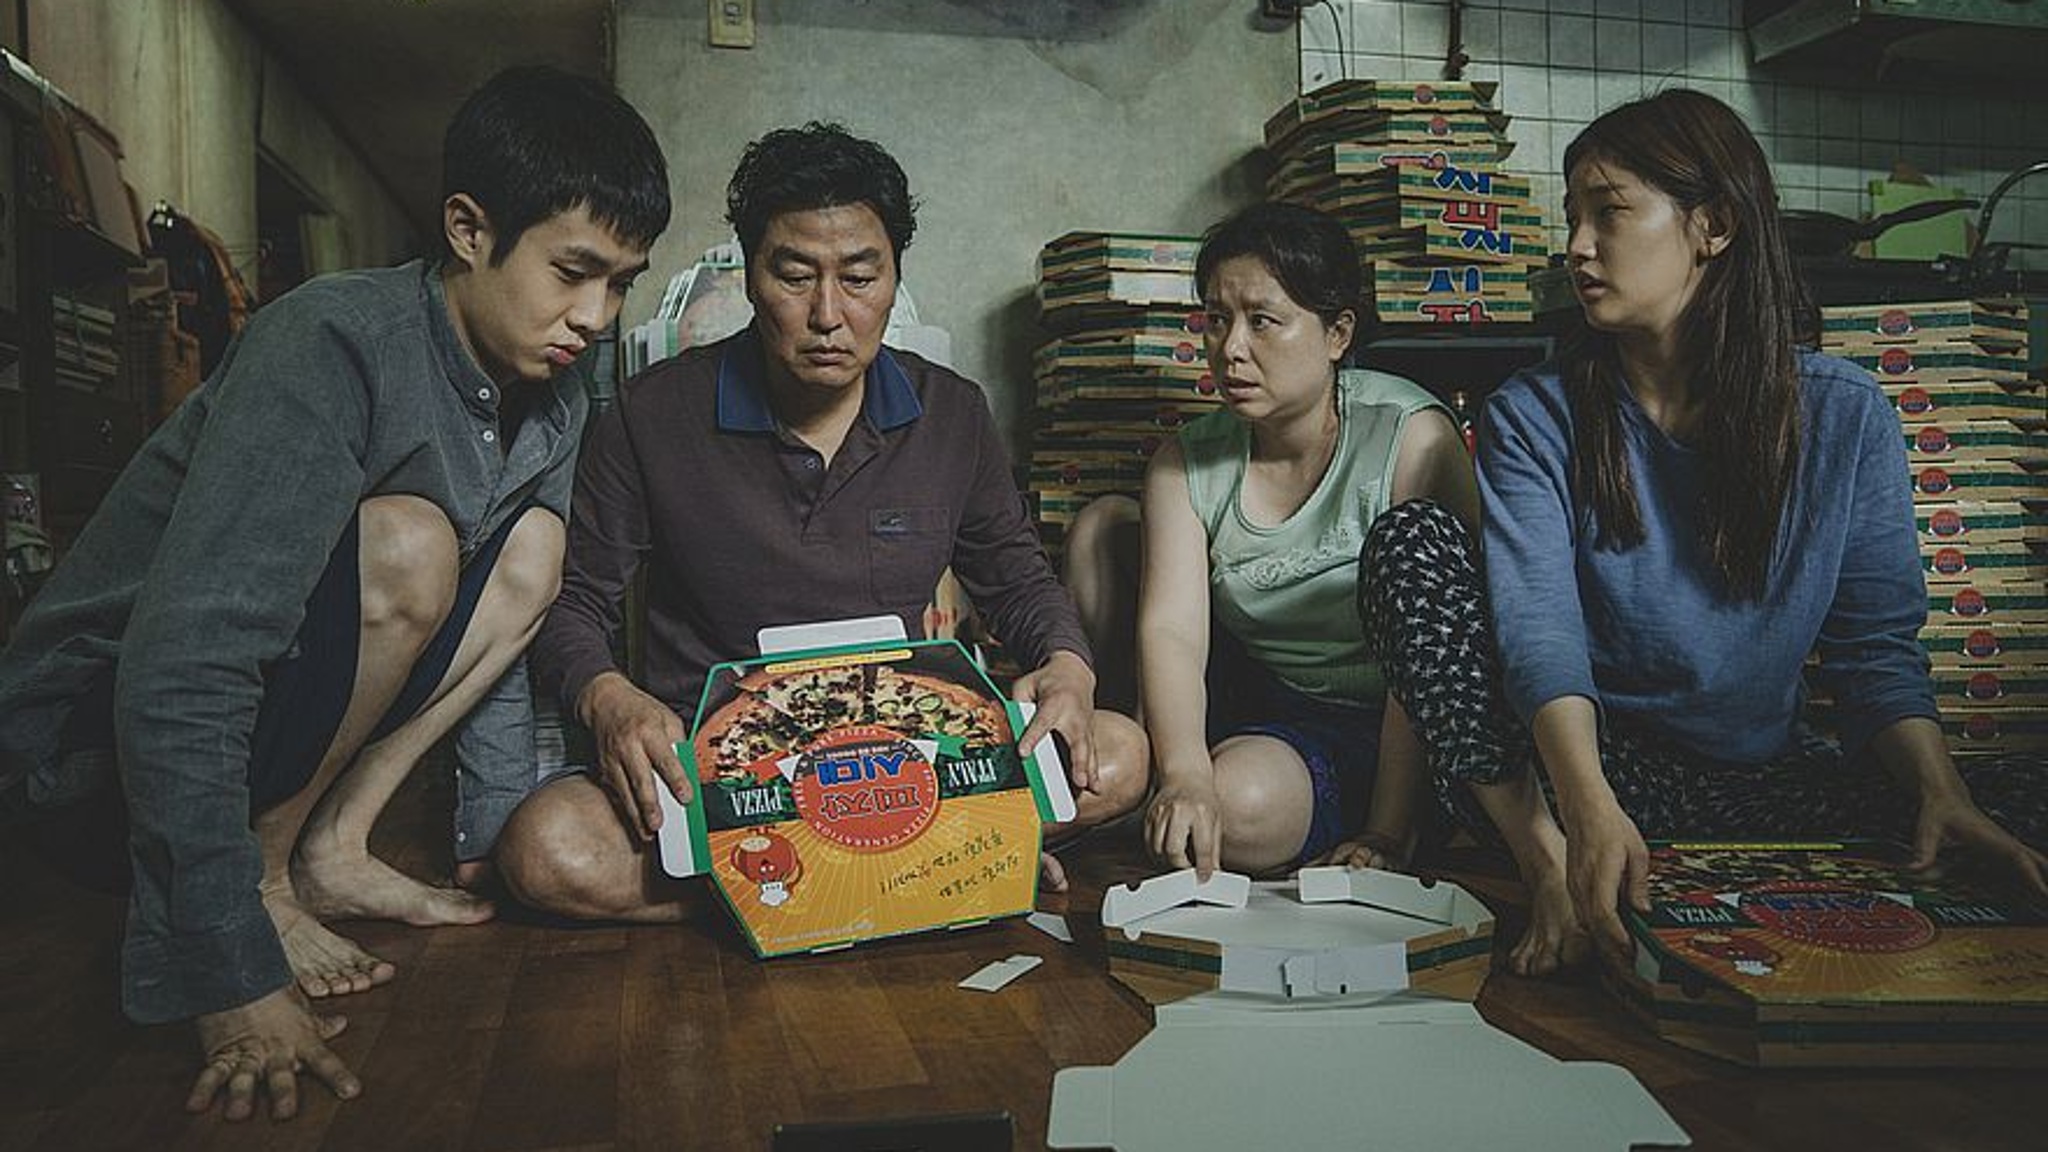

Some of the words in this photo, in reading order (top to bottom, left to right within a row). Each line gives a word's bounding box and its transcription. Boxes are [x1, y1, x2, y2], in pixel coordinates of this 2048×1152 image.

[816, 752, 907, 786] 시대
[945, 757, 998, 789] ITALY
[730, 785, 783, 818] PIZZA
[820, 785, 920, 822] 피자
[814, 819, 900, 847] GENERATION
